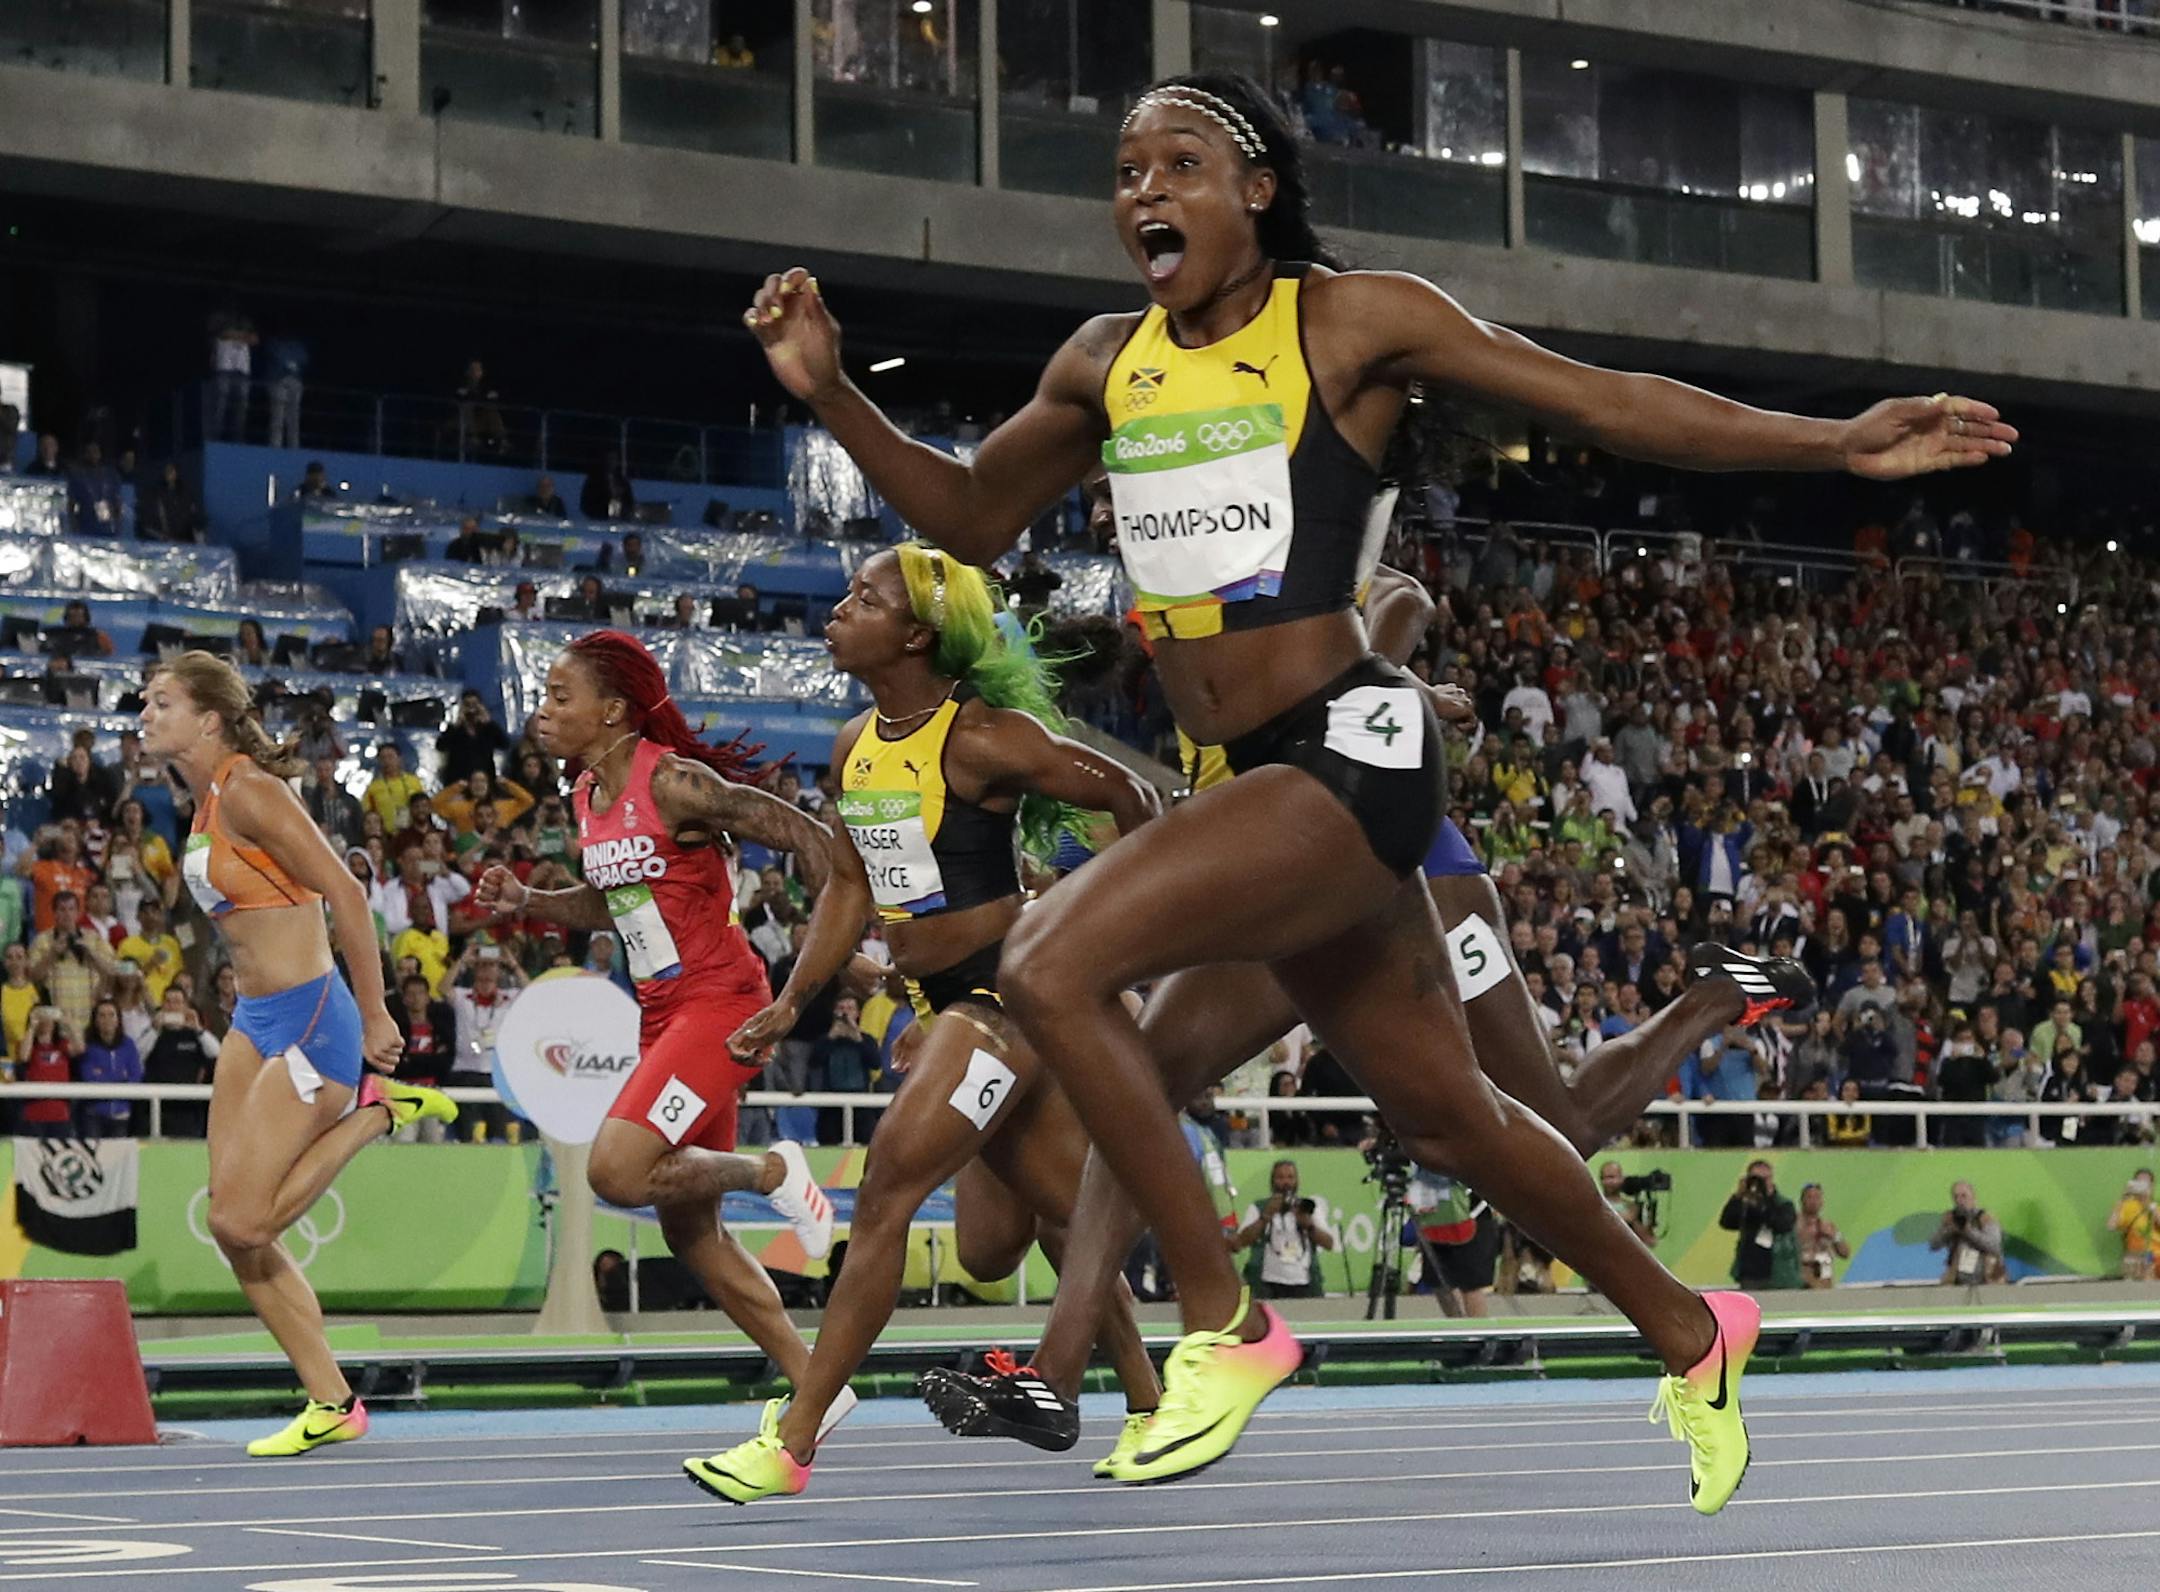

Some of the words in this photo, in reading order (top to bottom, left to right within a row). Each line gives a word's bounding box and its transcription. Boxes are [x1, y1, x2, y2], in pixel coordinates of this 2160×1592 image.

[1121, 502, 1272, 542] THOMPSON
[1365, 701, 1403, 747] 4
[847, 828, 903, 850] RASER
[868, 864, 910, 888] RYCE
[1460, 933, 1487, 978] 5
[575, 1053, 639, 1073] IAAF
[978, 1078, 1001, 1109] 6
[661, 1095, 685, 1123] 8
